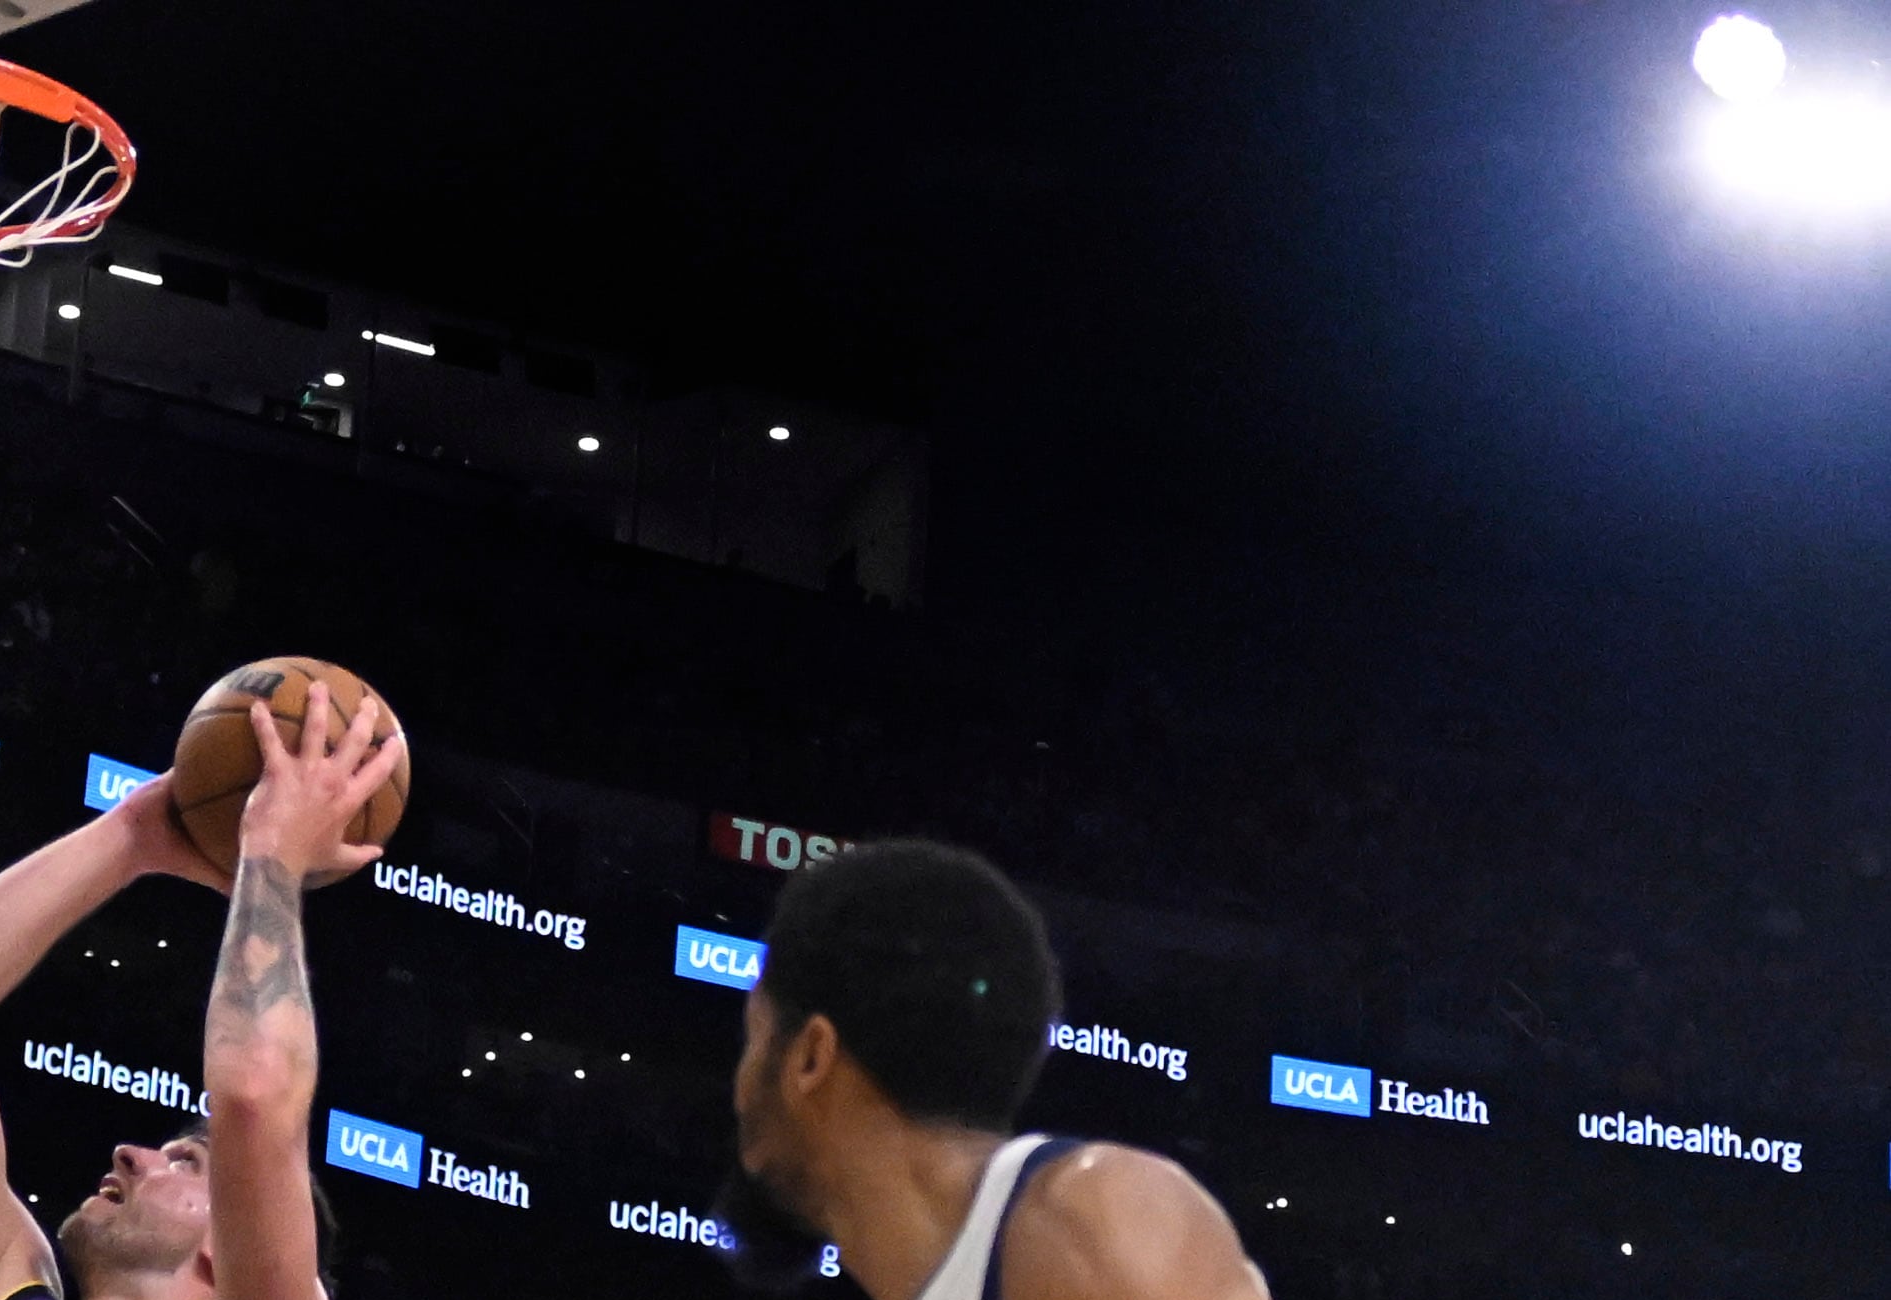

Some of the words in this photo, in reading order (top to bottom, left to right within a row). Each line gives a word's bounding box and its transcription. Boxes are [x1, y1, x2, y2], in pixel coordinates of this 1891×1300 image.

[730, 817, 856, 871] TOS
[374, 861, 588, 950] uclahealth.org
[1285, 1069, 1359, 1104] UCLA
[1378, 1079, 1490, 1125] Health
[340, 1126, 409, 1172] UCLA
[427, 1148, 530, 1209] Health
[1578, 1110, 1803, 1173] uclahealth.org
